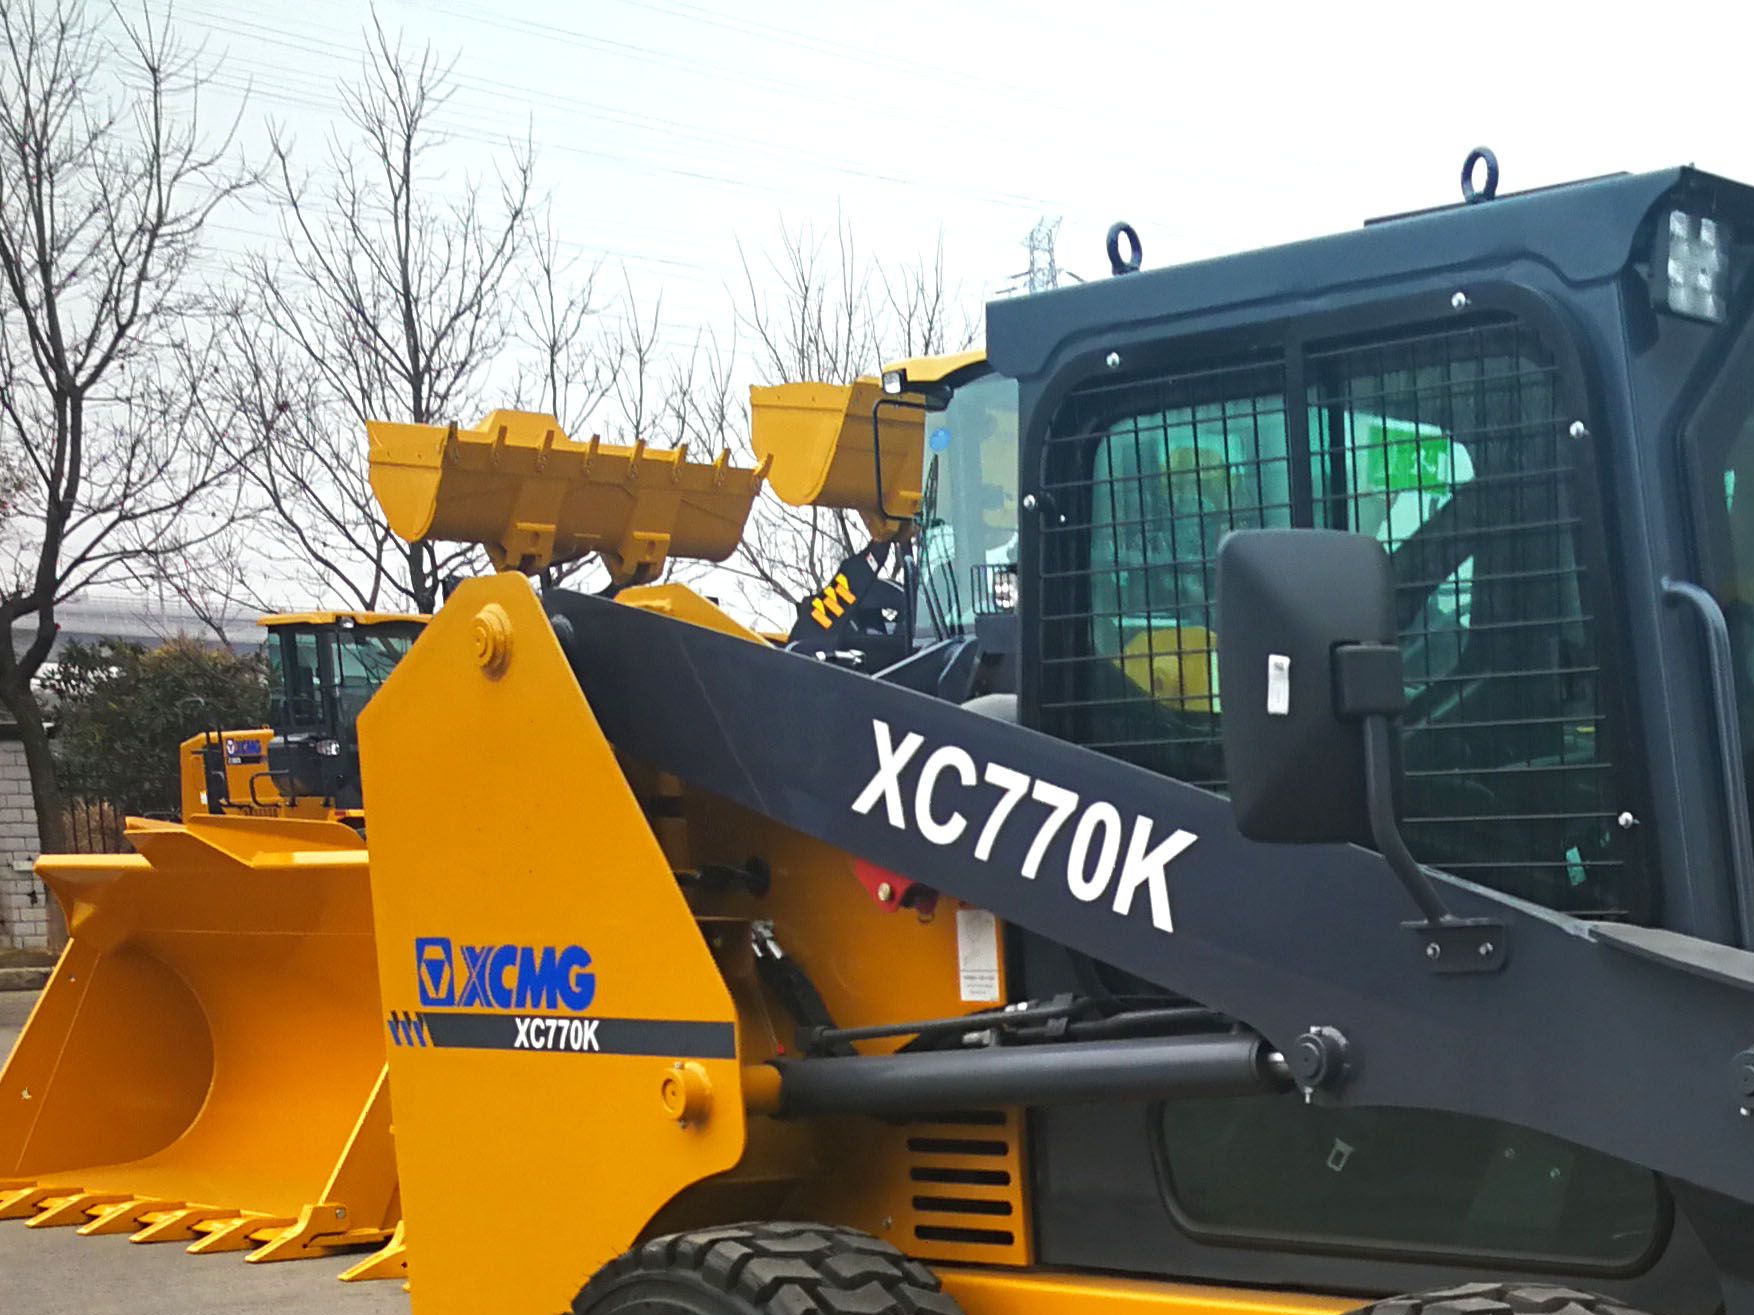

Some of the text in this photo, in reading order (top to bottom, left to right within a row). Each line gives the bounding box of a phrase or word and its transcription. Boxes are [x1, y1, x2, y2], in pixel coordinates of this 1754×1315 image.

[851, 718, 1199, 933] XC770K
[456, 945, 596, 1011] XCMG
[514, 1017, 600, 1051] XC770K
